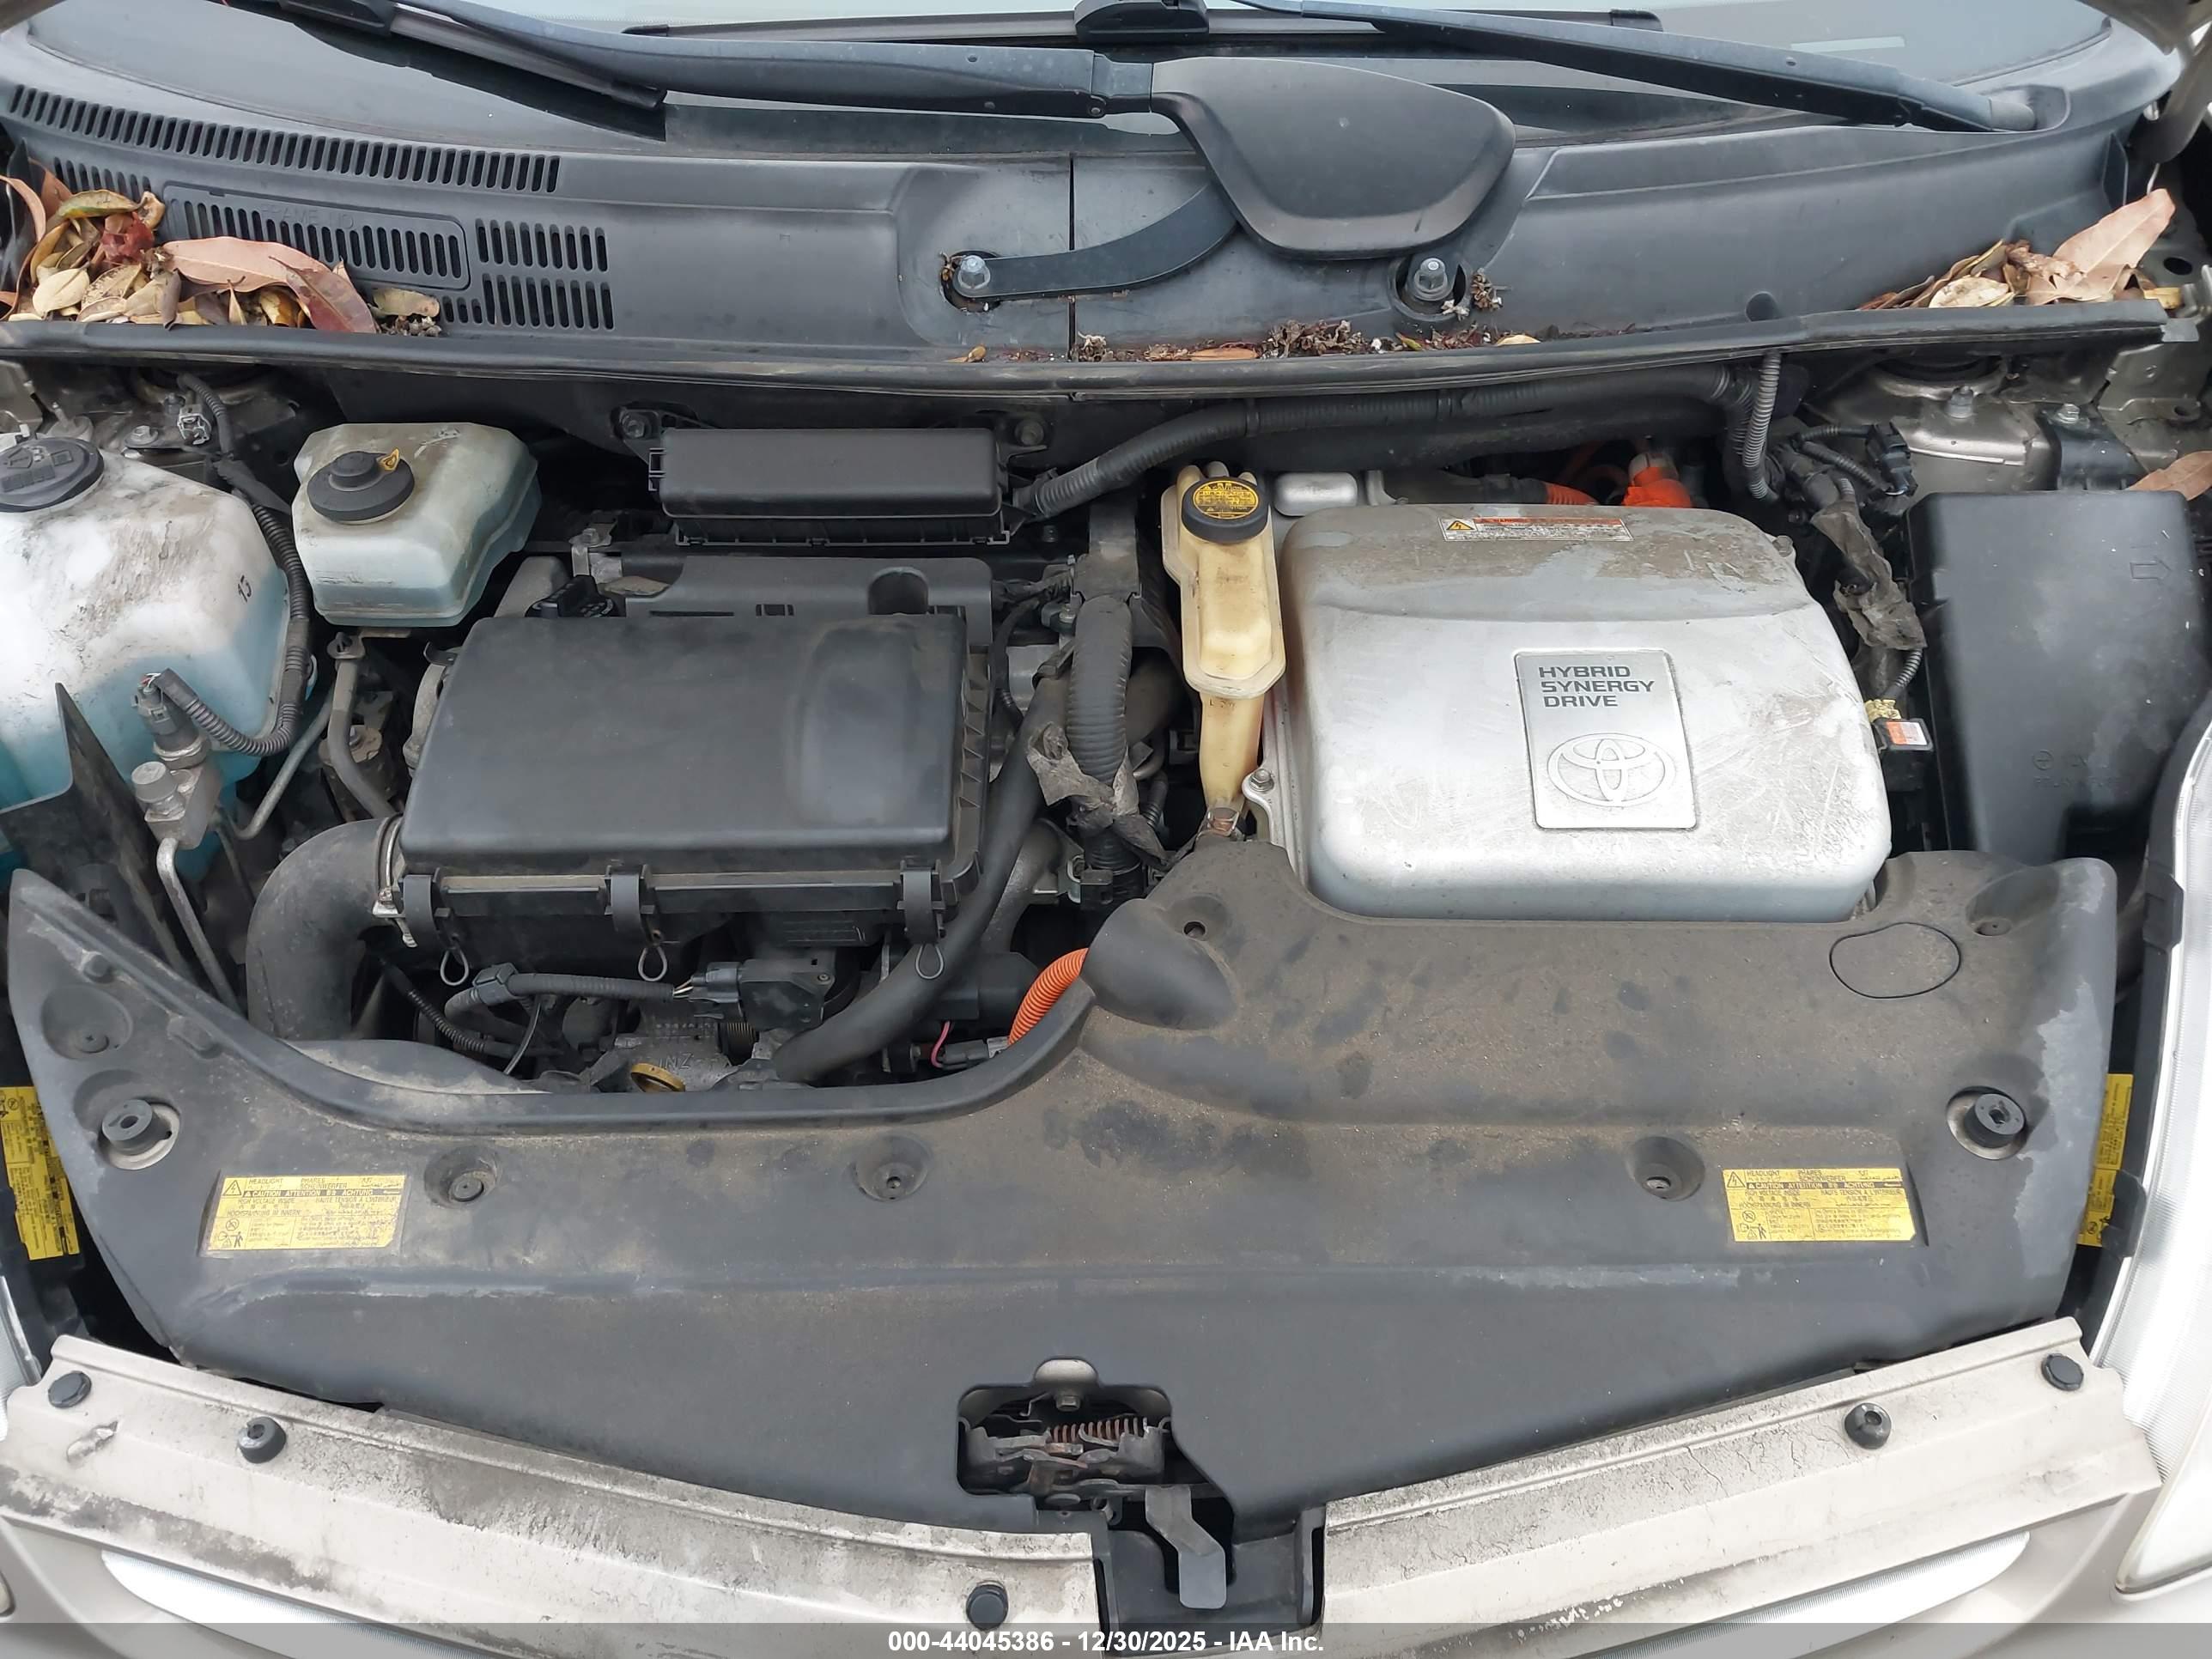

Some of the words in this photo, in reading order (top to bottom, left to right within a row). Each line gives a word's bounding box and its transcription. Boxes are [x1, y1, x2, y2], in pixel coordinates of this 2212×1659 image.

[1539, 666, 1631, 678] HYBRID
[1541, 680, 1656, 693] SYNERGY
[1544, 695, 1619, 708] DRIVE
